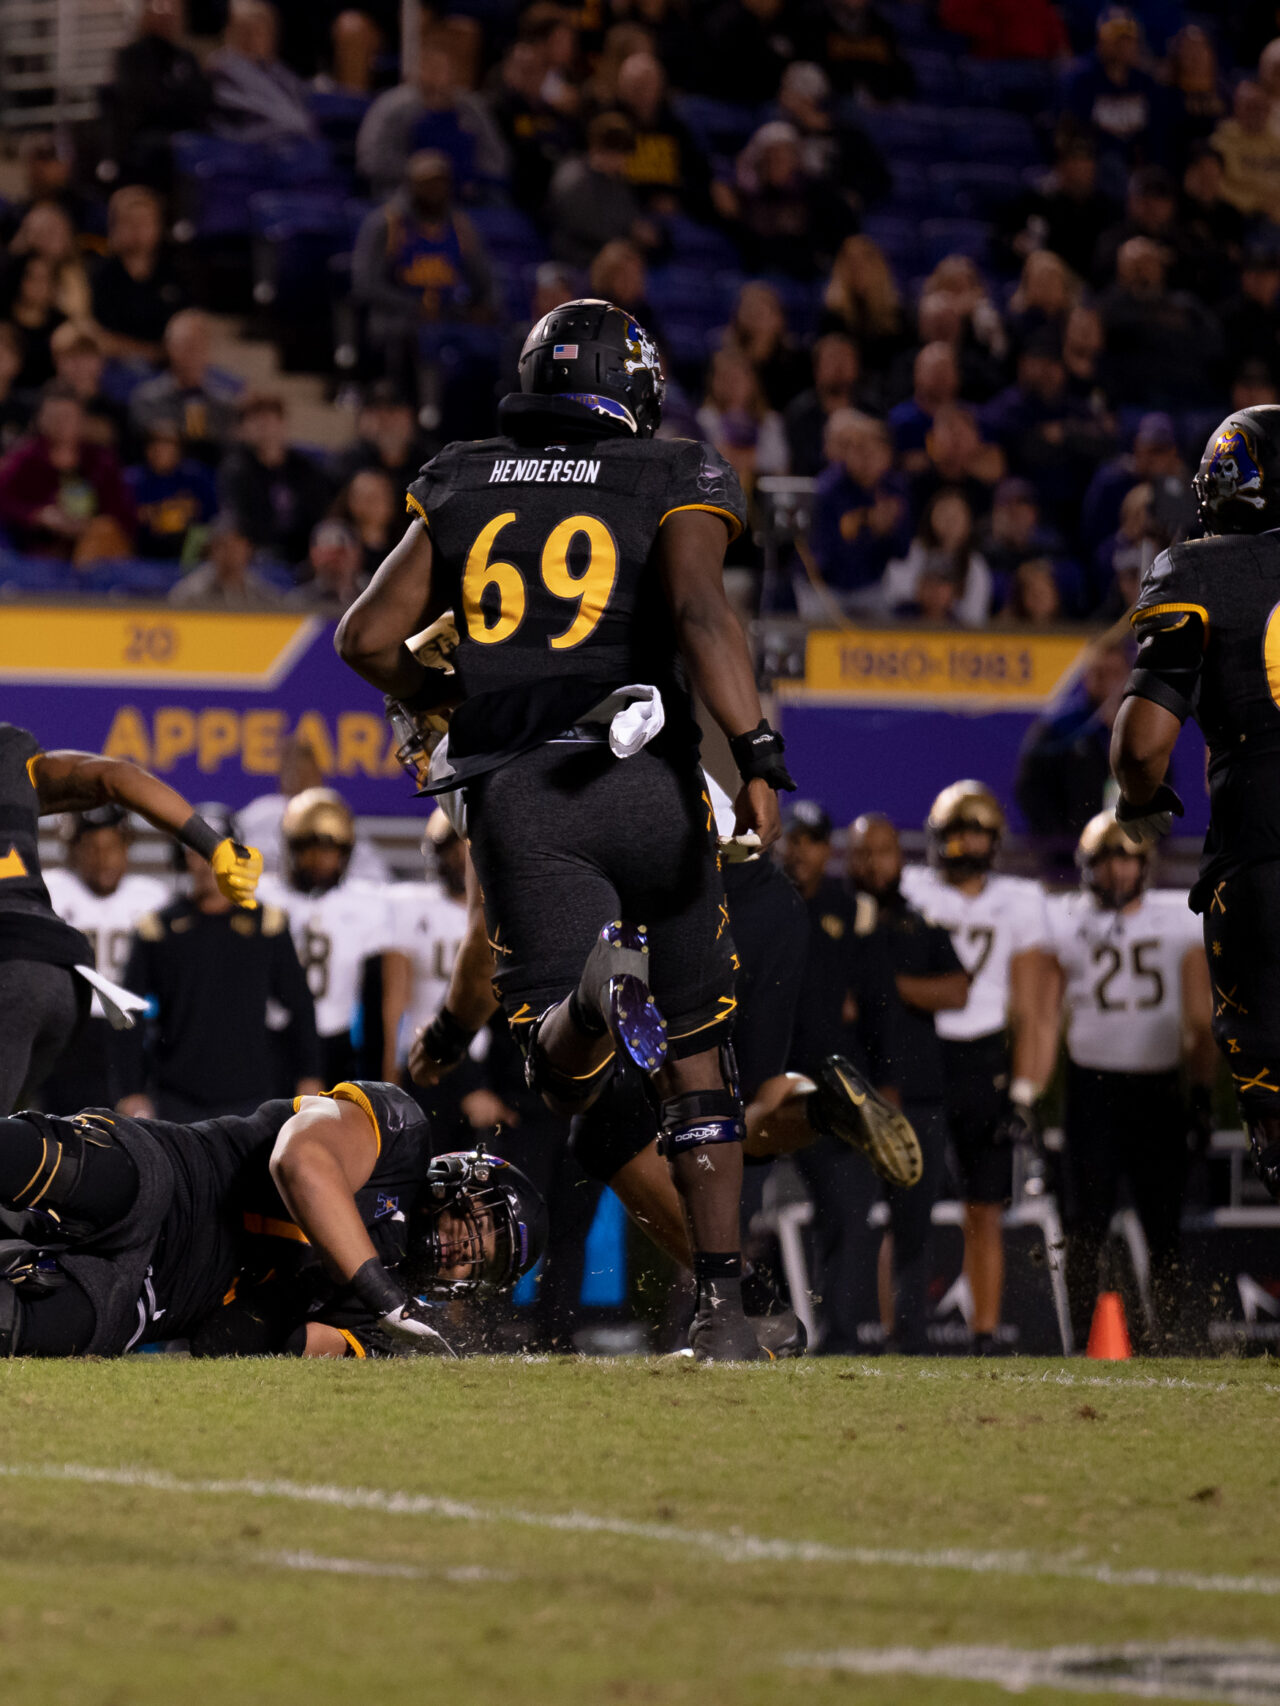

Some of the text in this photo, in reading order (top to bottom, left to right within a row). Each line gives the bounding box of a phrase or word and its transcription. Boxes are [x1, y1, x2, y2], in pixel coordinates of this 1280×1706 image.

[487, 459, 601, 483] HENDERSON
[462, 511, 618, 649] 69
[1090, 936, 1164, 1012] 25
[675, 1127, 722, 1142] DONJOY
